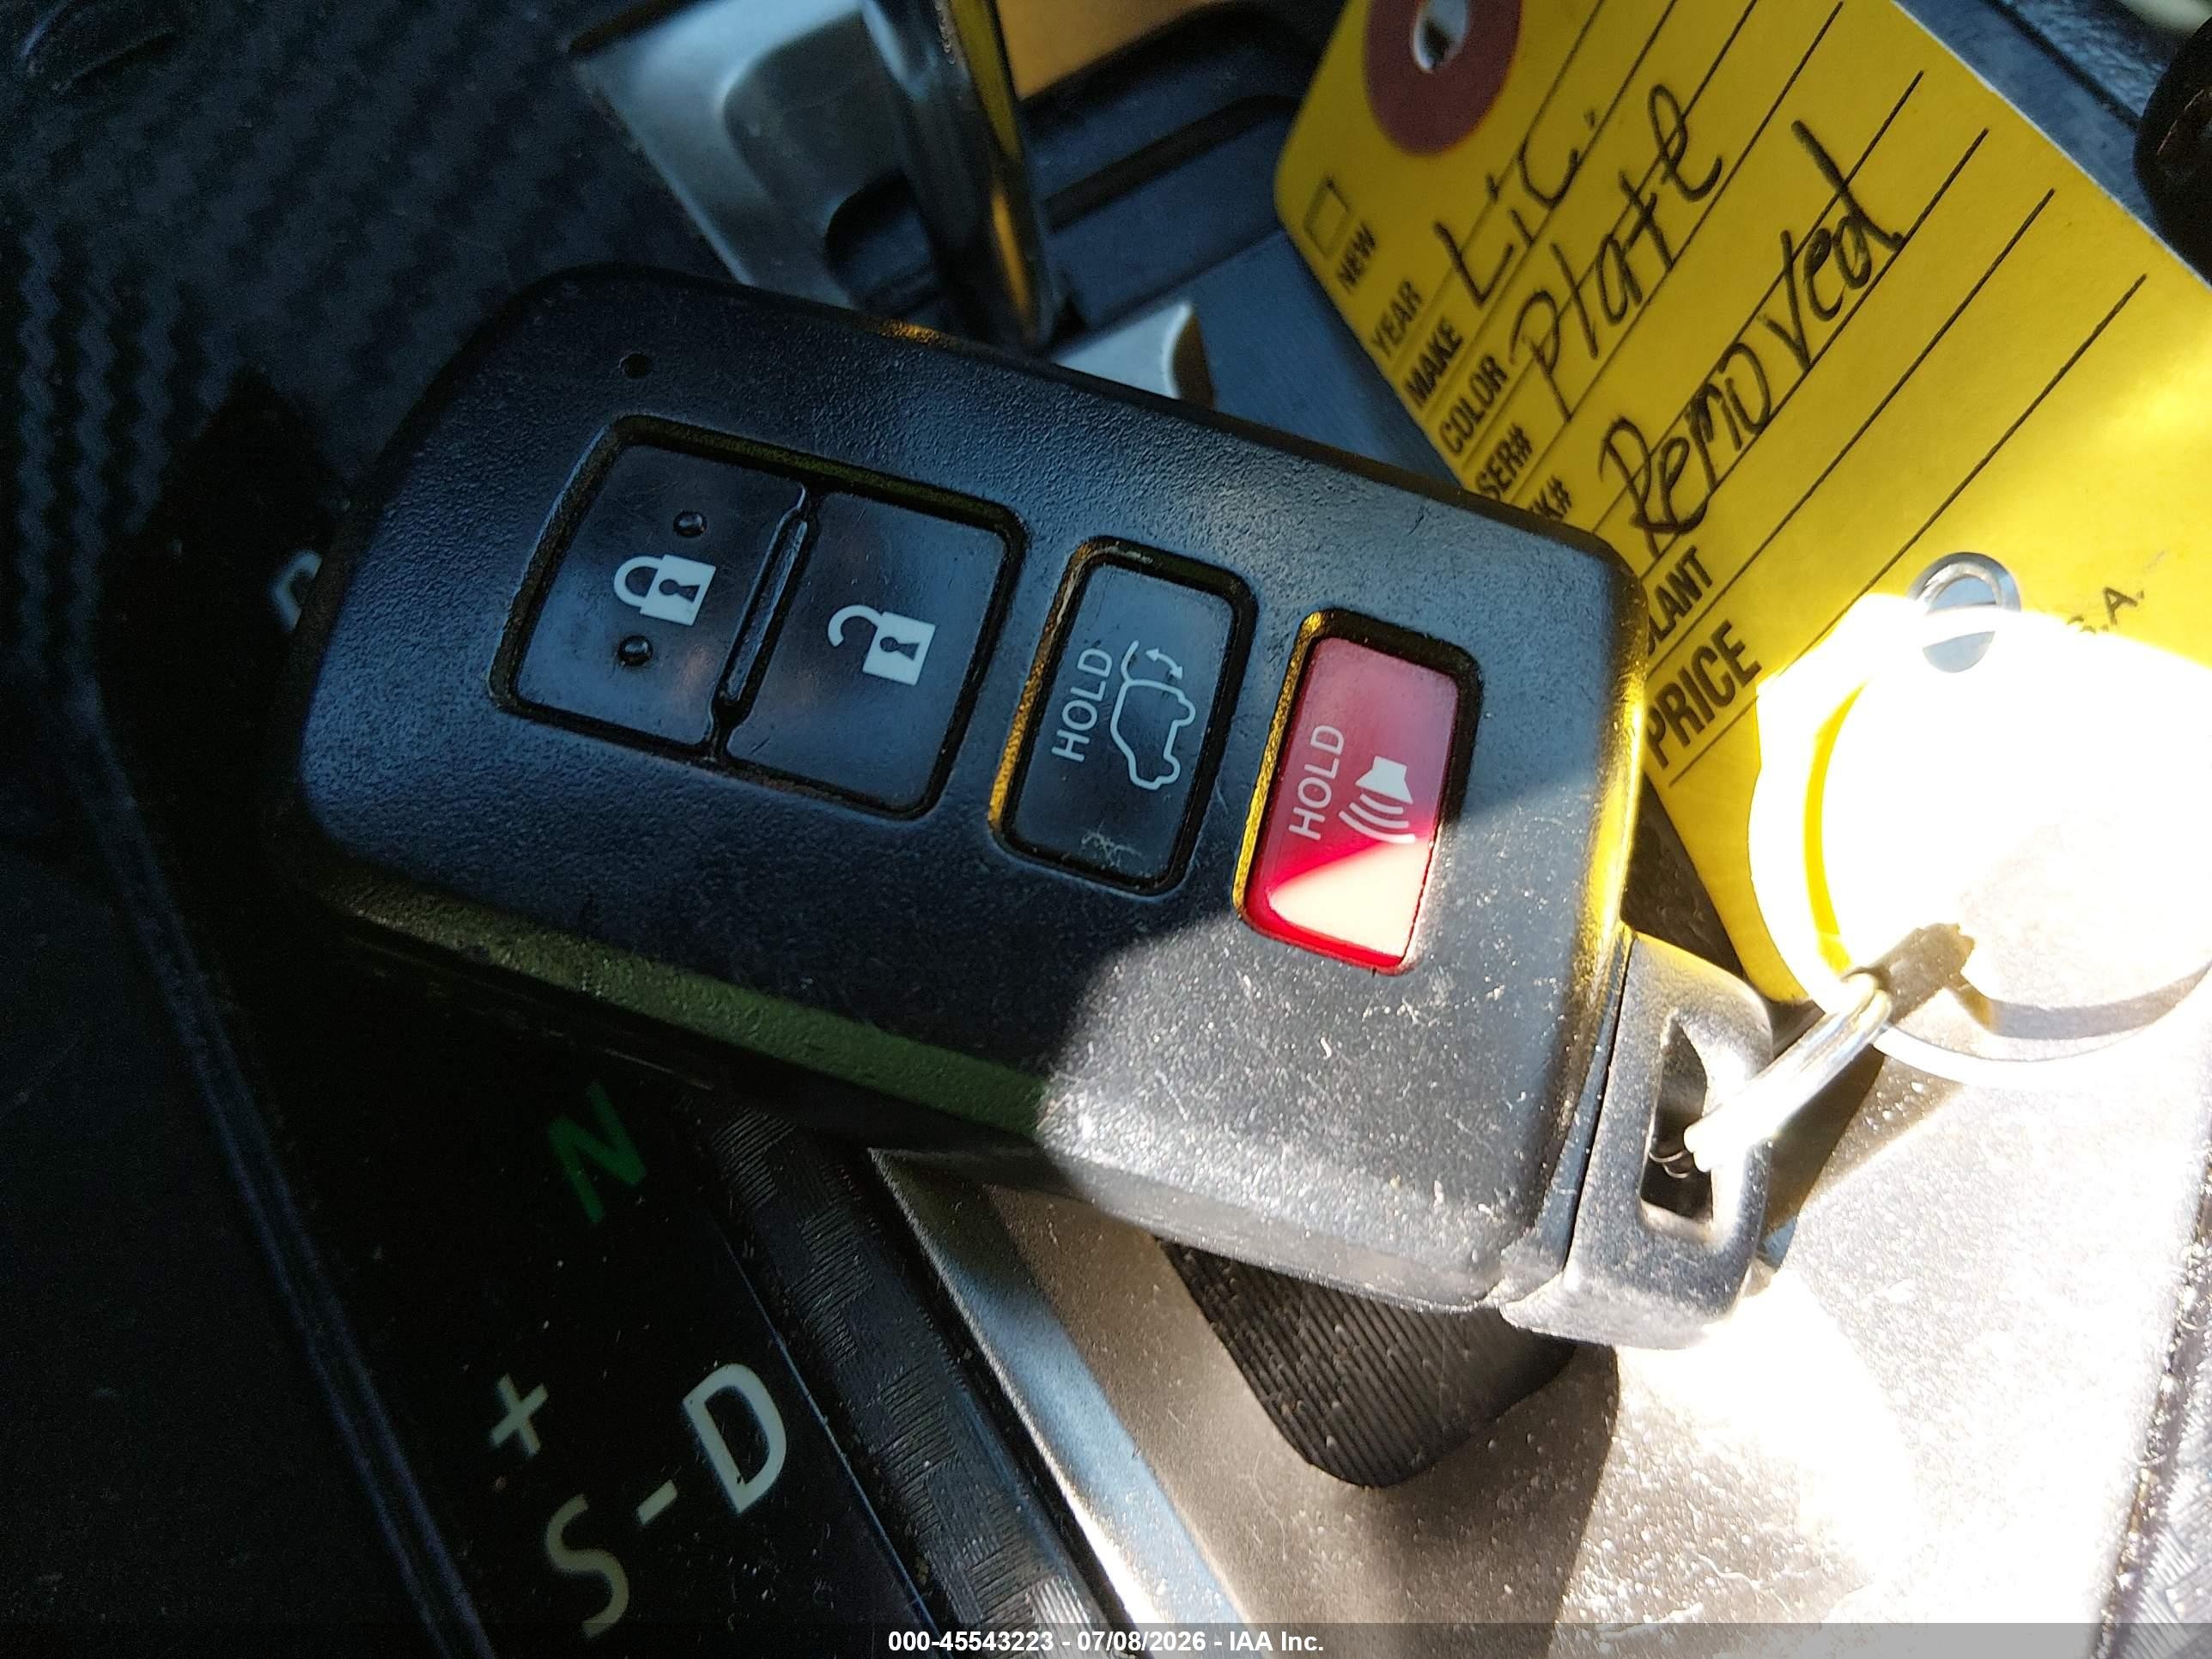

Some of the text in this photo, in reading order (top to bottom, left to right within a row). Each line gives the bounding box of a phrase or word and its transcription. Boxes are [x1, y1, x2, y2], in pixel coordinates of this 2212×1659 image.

[1337, 221, 1376, 295] NEW
[1373, 279, 1422, 359] YEAR
[1404, 316, 1464, 409] MAKE
[1599, 120, 1904, 560] Removed
[1439, 354, 1509, 457] COLOR
[1475, 422, 1533, 501] SER#
[1648, 544, 1713, 658] LANT
[1052, 647, 1112, 763] HOLD
[1645, 618, 1763, 770] PRICE
[1288, 724, 1346, 841] HOLD
[547, 1079, 647, 1224] N
